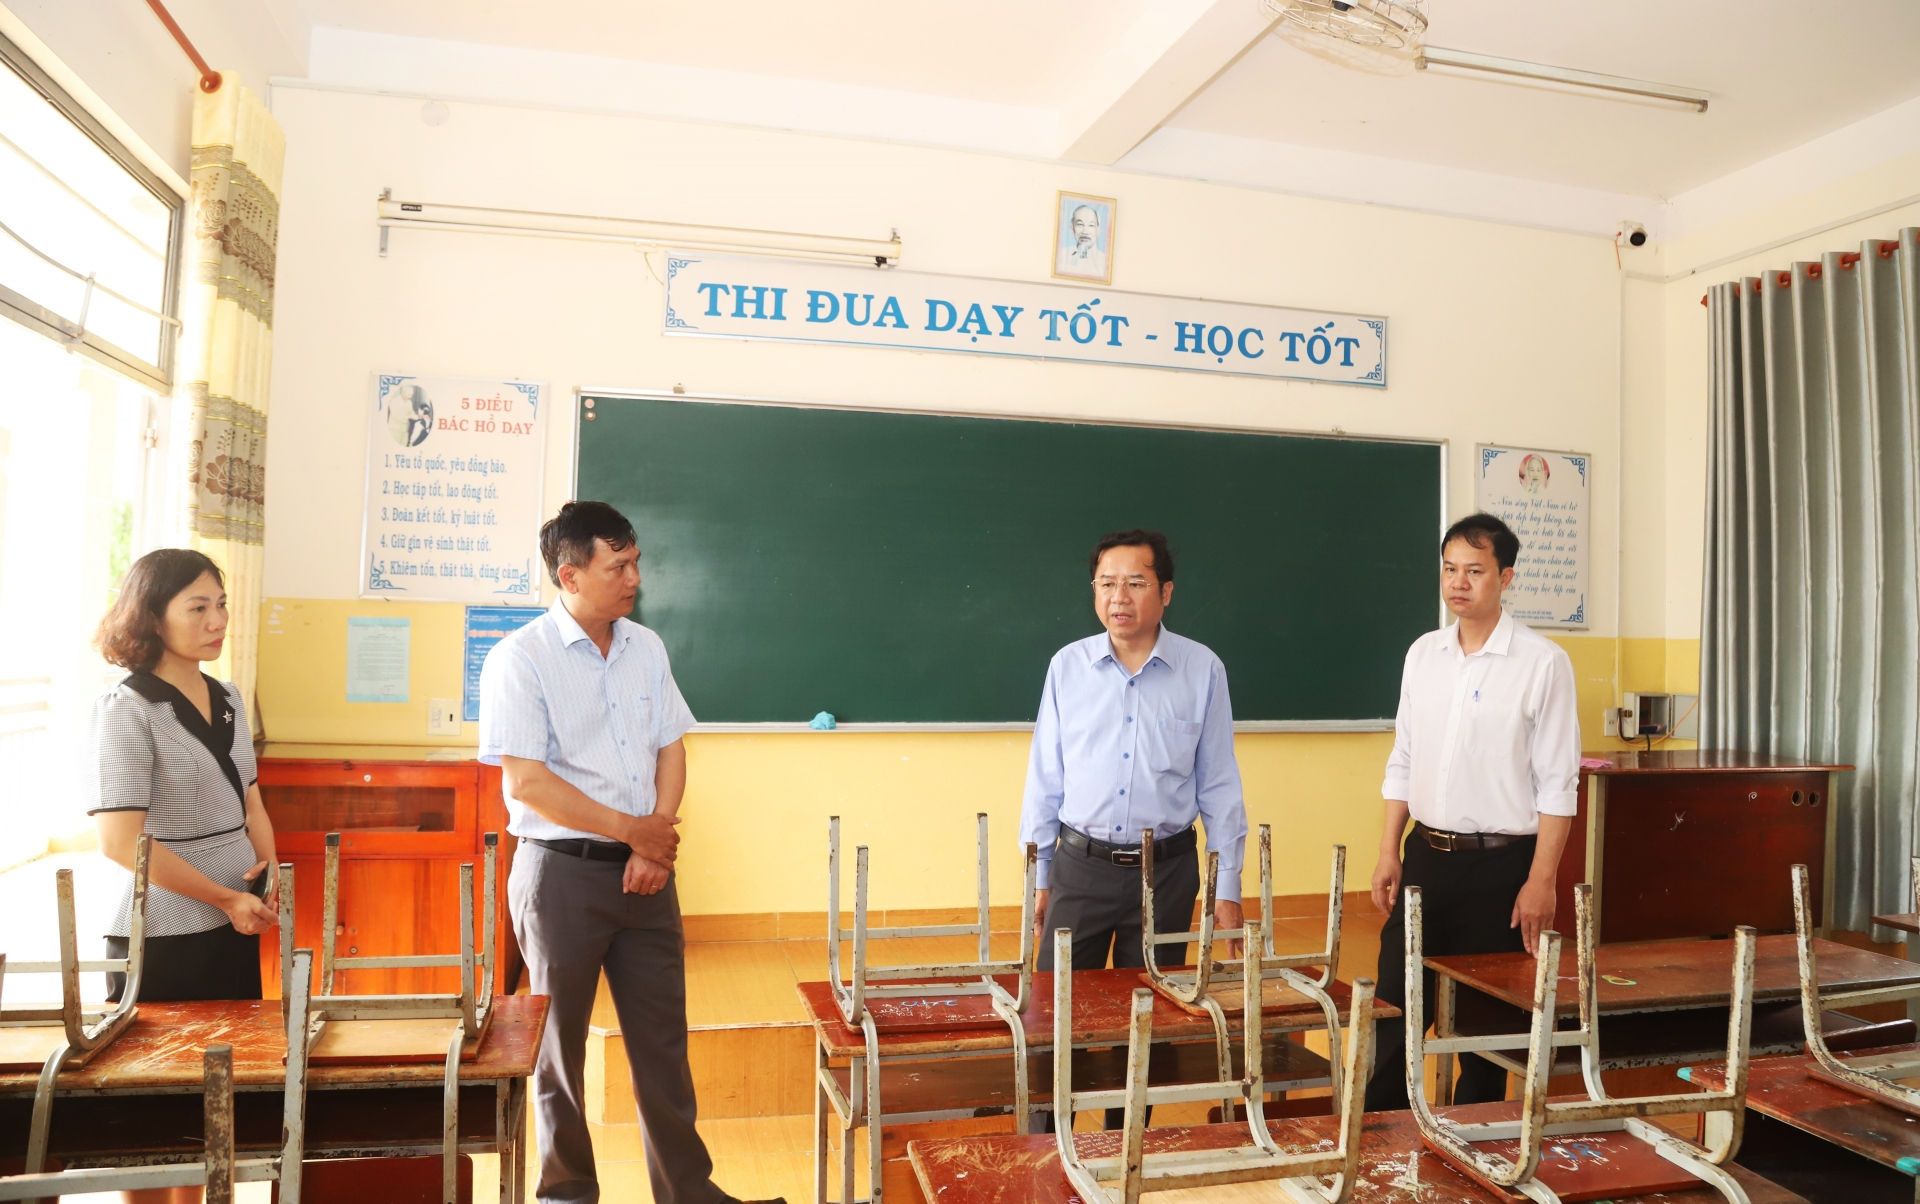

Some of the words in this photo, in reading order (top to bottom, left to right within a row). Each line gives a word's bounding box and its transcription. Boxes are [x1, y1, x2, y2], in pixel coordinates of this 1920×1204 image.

[697, 282, 788, 320] THI
[805, 289, 909, 329] ĐUA
[924, 298, 1024, 343] DẠY
[1039, 298, 1130, 347] TỐT
[1174, 321, 1265, 364] HỌC
[1279, 321, 1361, 367] TỐT
[461, 397, 470, 410] 5
[475, 392, 513, 412] ĐIỀU
[438, 415, 468, 431] BÁC
[474, 413, 496, 433] HỒ
[502, 421, 534, 437] DẠY
[395, 454, 411, 469] Yêu
[449, 457, 465, 475] yêu
[393, 480, 410, 498] Học
[412, 482, 426, 500] tập
[446, 483, 459, 498] lao
[461, 484, 482, 503] động
[416, 506, 430, 523] kết
[463, 510, 480, 528] luật
[391, 533, 406, 549] Giữ
[408, 534, 421, 554] gìn
[436, 536, 454, 551] sinh
[457, 537, 474, 555] thật
[390, 560, 417, 576] Khiêm
[440, 562, 457, 579] thật
[479, 563, 500, 583] dũng
